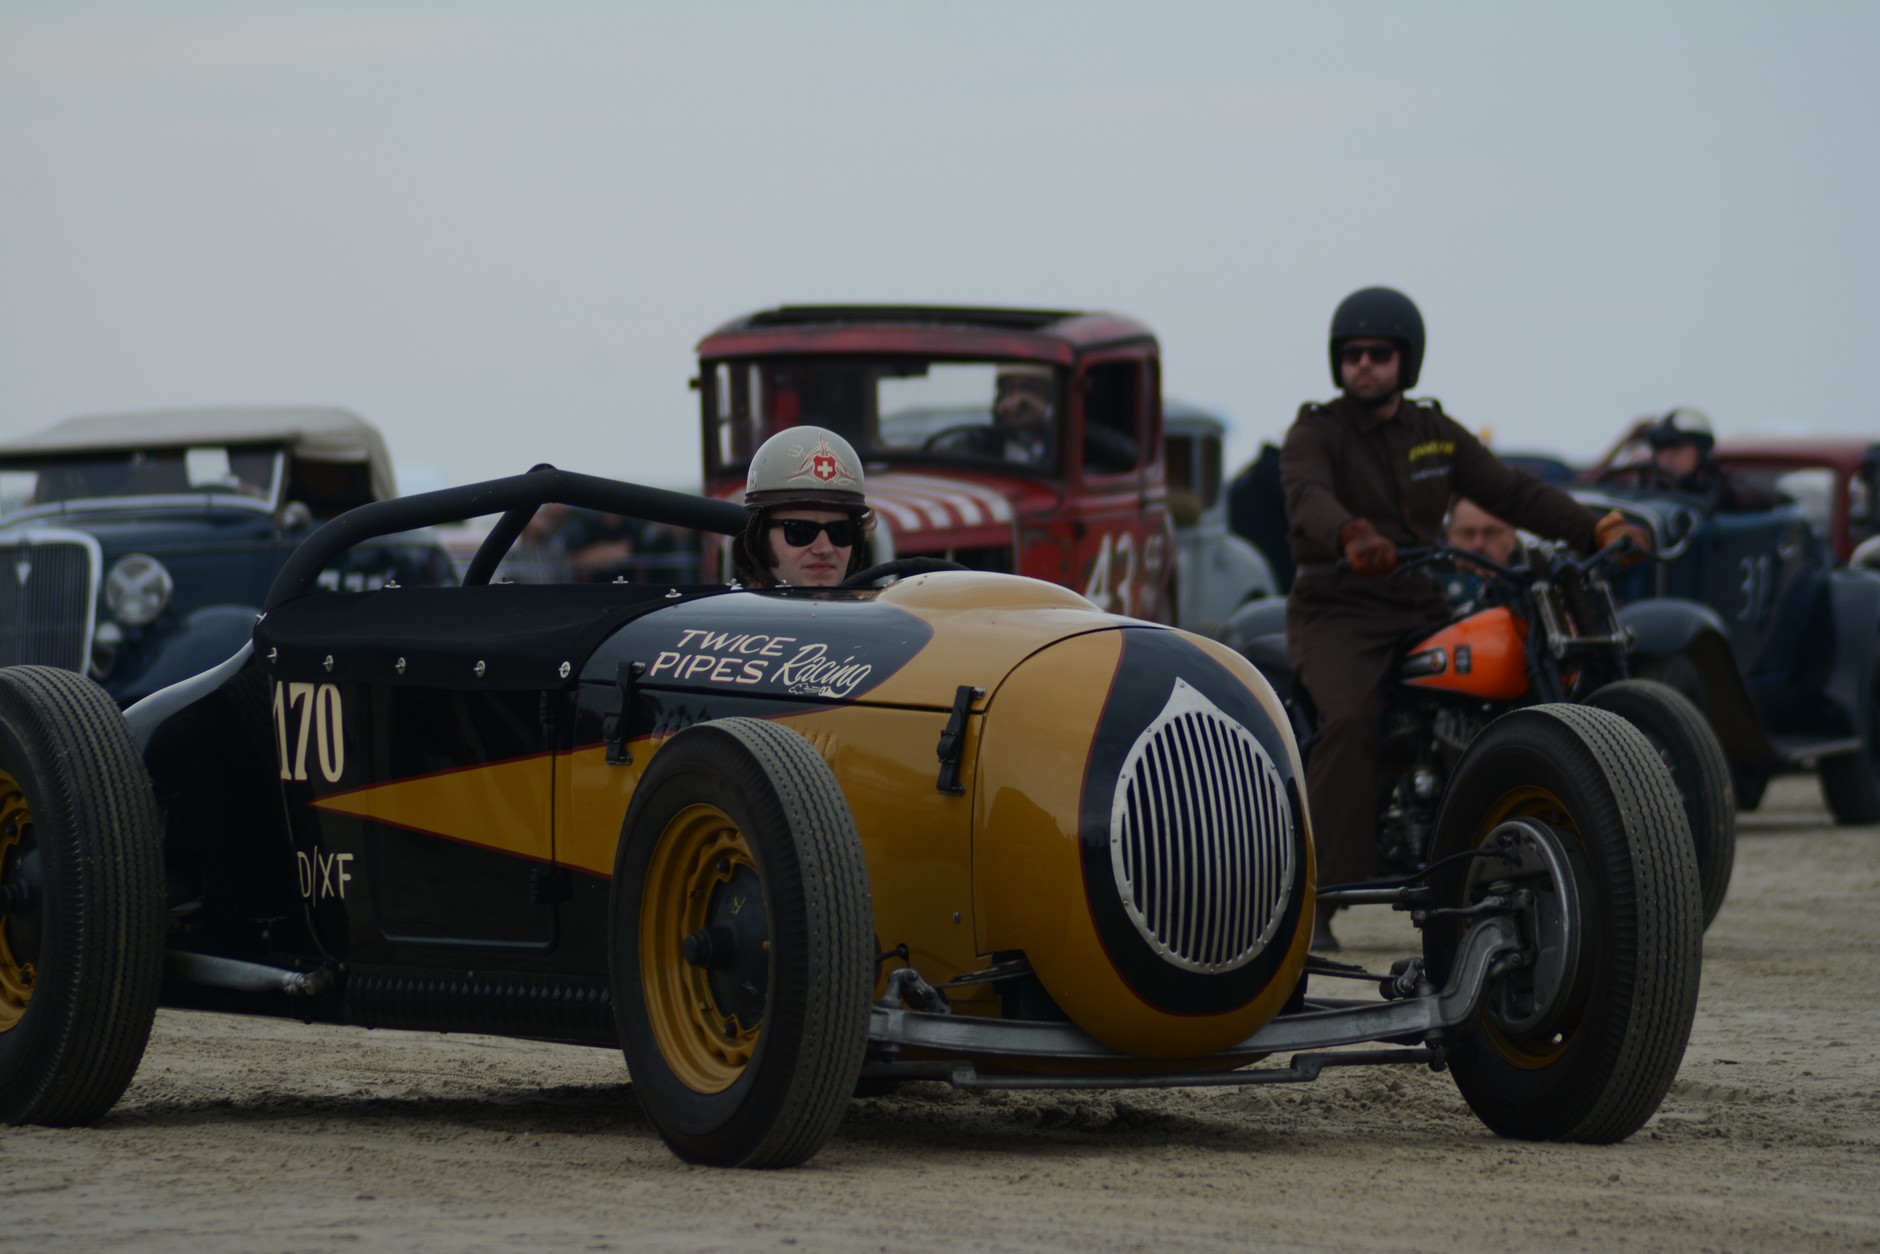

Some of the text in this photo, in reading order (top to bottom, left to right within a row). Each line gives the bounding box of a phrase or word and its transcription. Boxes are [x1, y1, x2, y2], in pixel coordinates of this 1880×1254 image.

[650, 651, 769, 684] PIPES
[677, 629, 797, 656] TWICE
[770, 643, 872, 698] Racing
[272, 680, 344, 783] 170
[296, 845, 354, 909] D/XF
